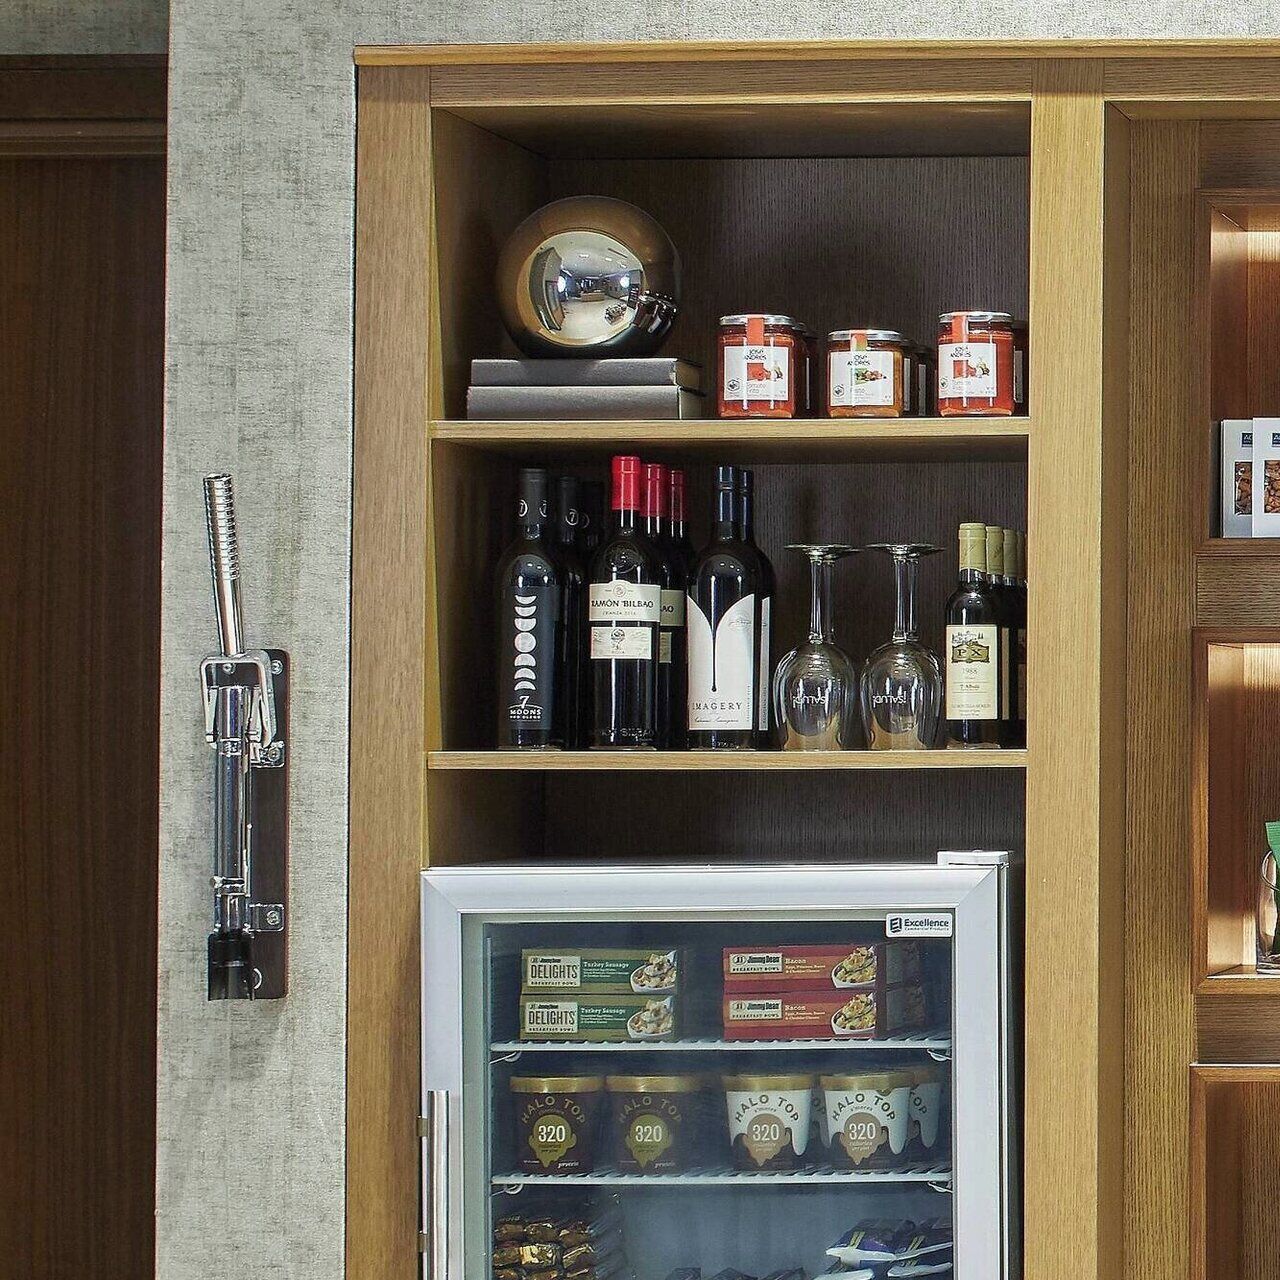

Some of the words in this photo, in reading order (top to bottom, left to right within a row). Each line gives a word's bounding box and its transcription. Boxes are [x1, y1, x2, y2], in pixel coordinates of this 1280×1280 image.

[623, 600, 654, 609] BILBAO
[692, 702, 743, 711] IMAGERY
[904, 918, 949, 927] Excellence
[531, 964, 578, 980] DELIGHTS
[528, 1010, 575, 1025] DELIGHTS
[735, 1094, 770, 1123] HALO
[778, 1096, 799, 1123] TOP
[832, 1093, 866, 1122] HALO
[874, 1095, 896, 1121] TOP
[538, 1124, 566, 1142] 320
[635, 1124, 663, 1142] 320
[752, 1123, 780, 1141] 320
[849, 1122, 877, 1140] 320
